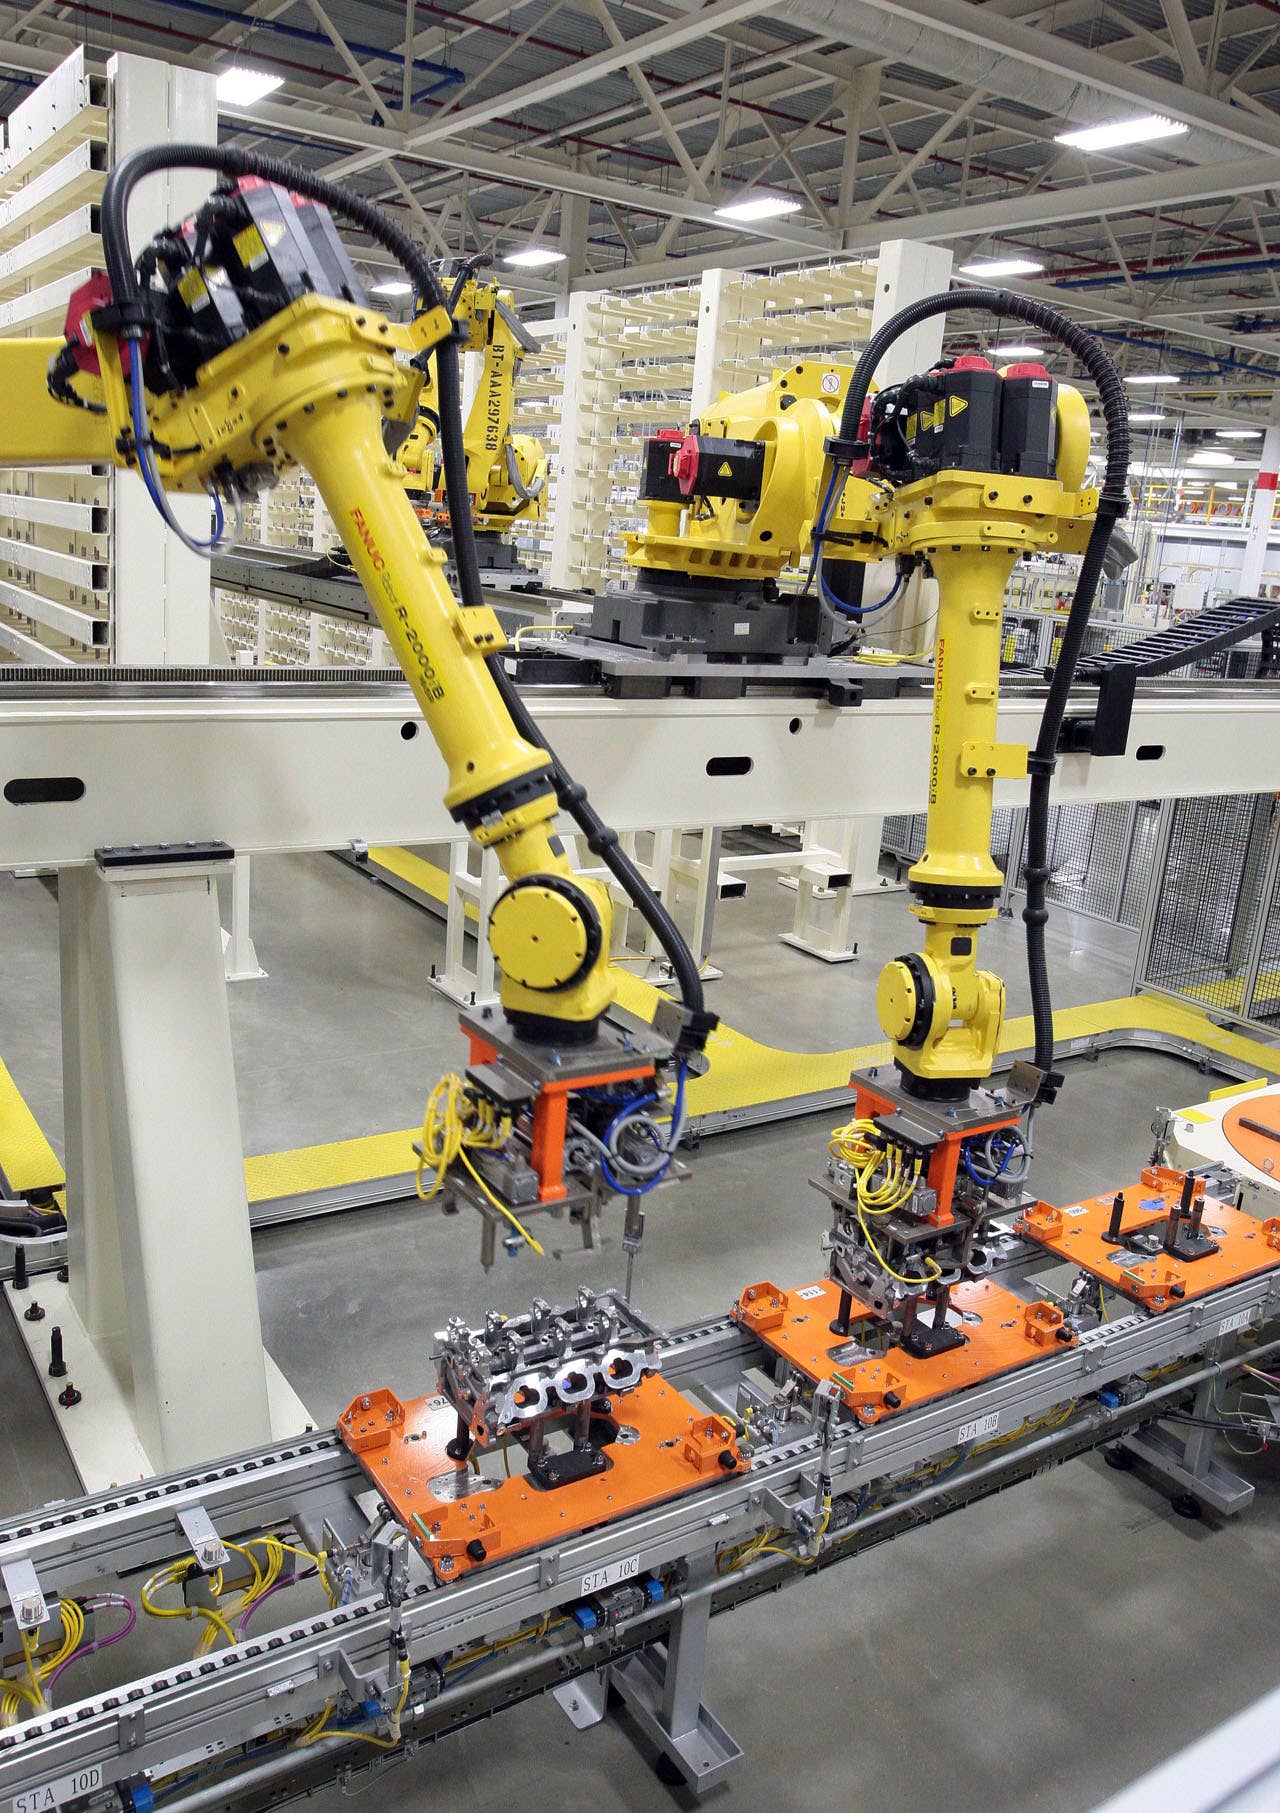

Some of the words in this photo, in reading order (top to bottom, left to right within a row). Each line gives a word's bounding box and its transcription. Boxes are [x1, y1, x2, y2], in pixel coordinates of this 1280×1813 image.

[485, 344, 505, 451] BT-AAA297638
[351, 506, 385, 571] FANUC
[936, 638, 945, 692] FANUC
[960, 1422, 976, 1440] STA
[583, 1570, 608, 1592] STA
[618, 1558, 638, 1577] 10C
[16, 1787, 55, 1813] STA
[71, 1769, 99, 1795] 10D
